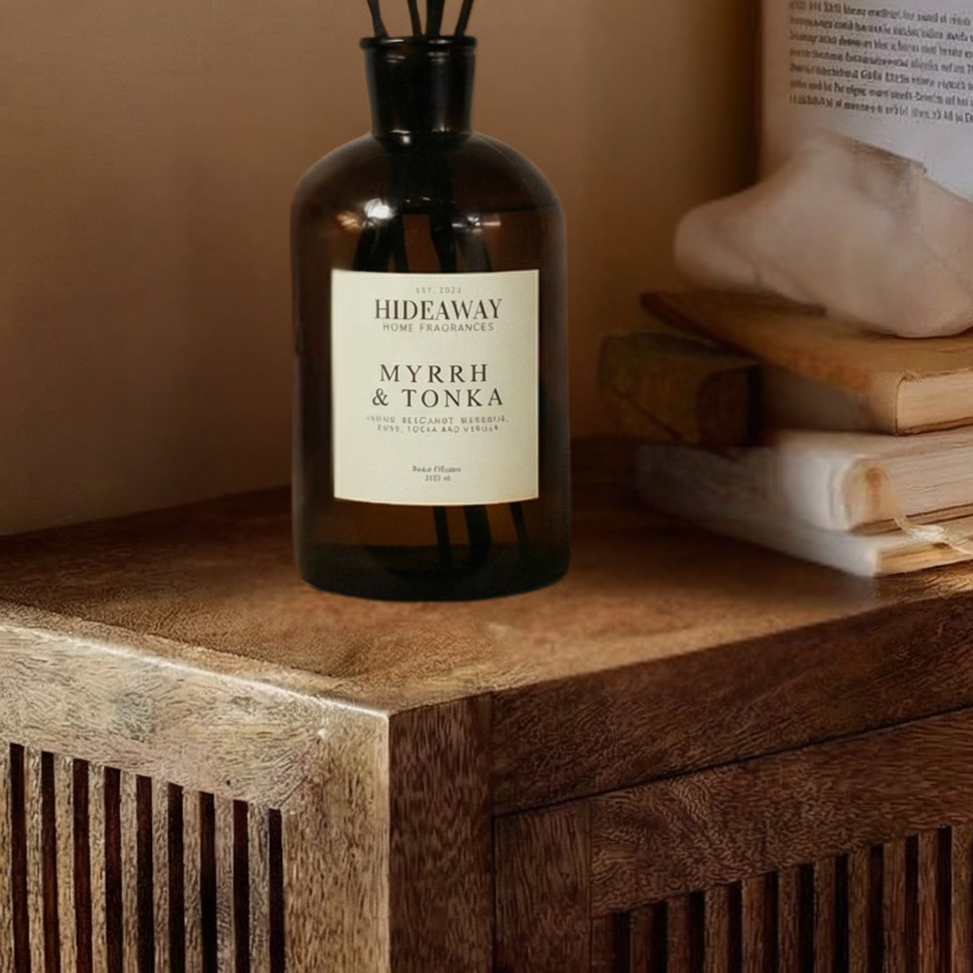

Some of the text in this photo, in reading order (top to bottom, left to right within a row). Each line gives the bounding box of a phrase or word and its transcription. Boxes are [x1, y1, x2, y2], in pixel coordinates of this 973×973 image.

[375, 298, 502, 320] HIDEAWAY
[383, 322, 414, 333] HOME
[379, 363, 488, 383] MYRRH
[371, 387, 504, 408] & TONKA
